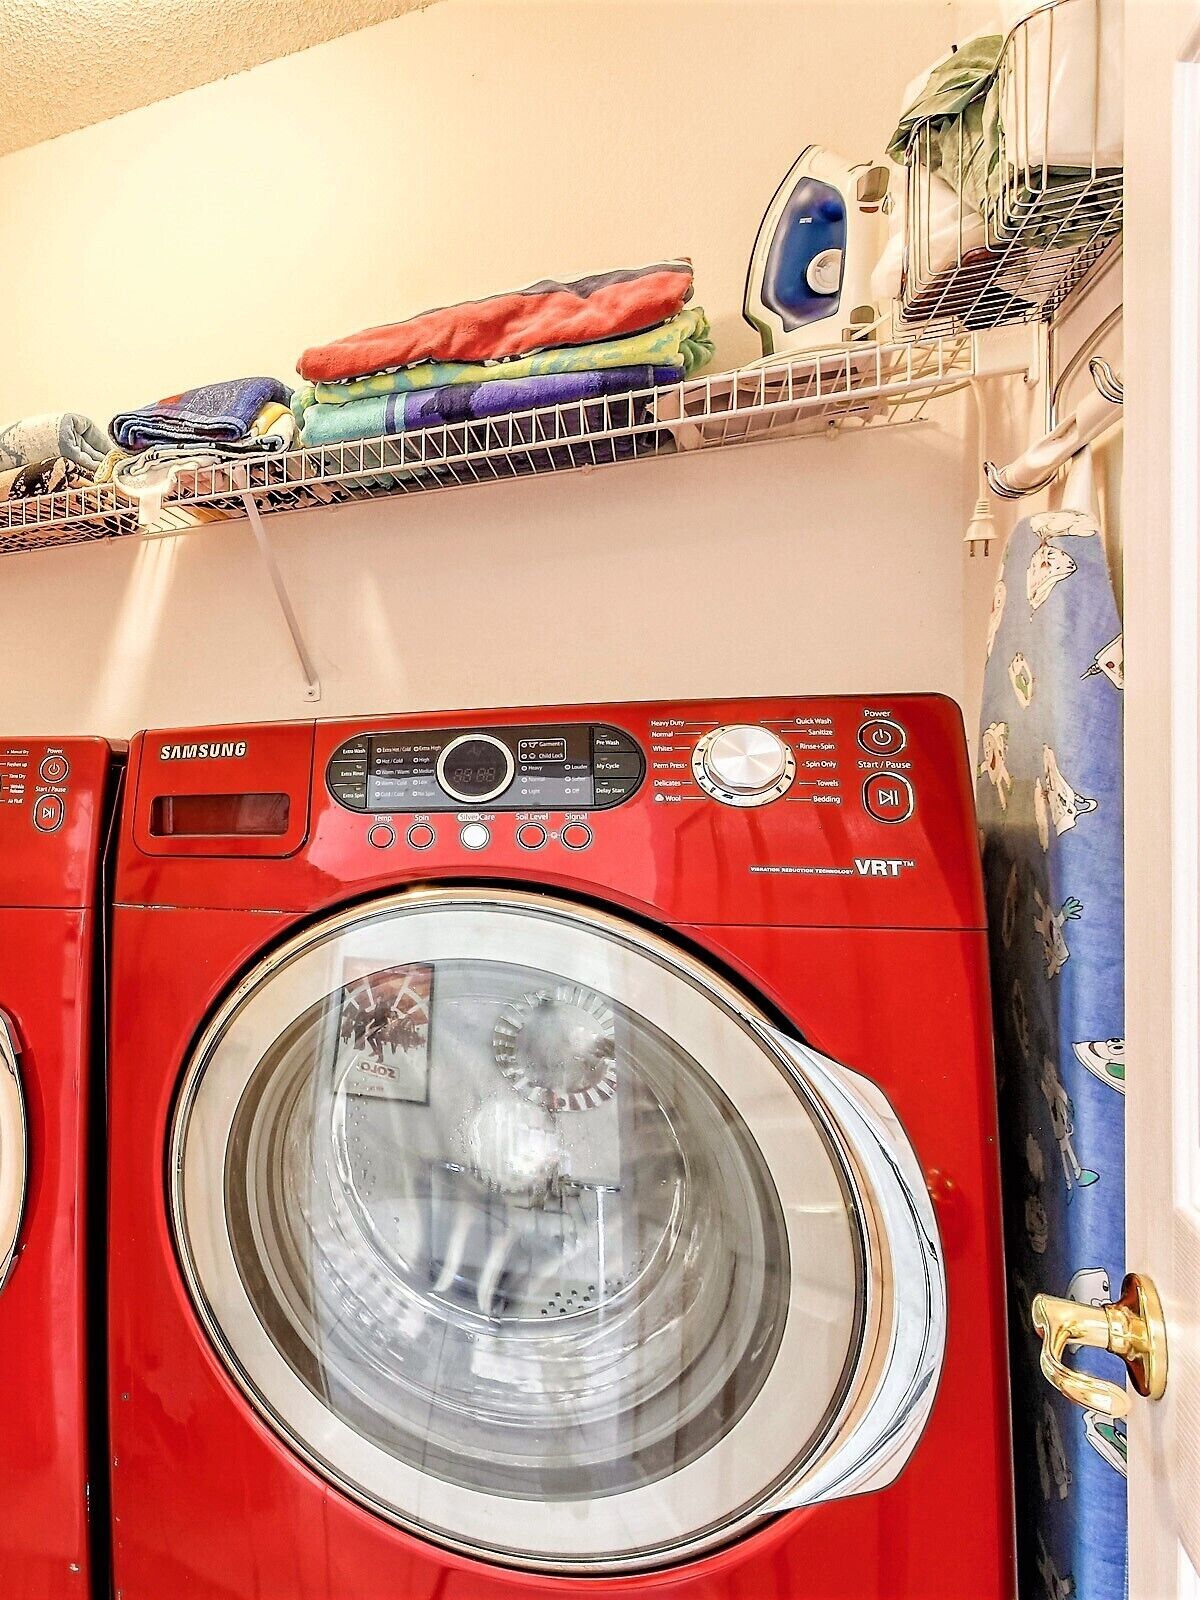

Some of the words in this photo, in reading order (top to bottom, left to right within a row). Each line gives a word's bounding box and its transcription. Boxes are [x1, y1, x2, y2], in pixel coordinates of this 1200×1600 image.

[160, 742, 246, 760] SAMSUNG
[800, 743, 835, 751] Rinse+Spin
[821, 761, 836, 769] Only
[858, 760, 878, 768] Start
[813, 796, 841, 804] Bedding
[374, 815, 393, 823] Temp.
[414, 814, 429, 823] Spin
[565, 813, 587, 822] Signal
